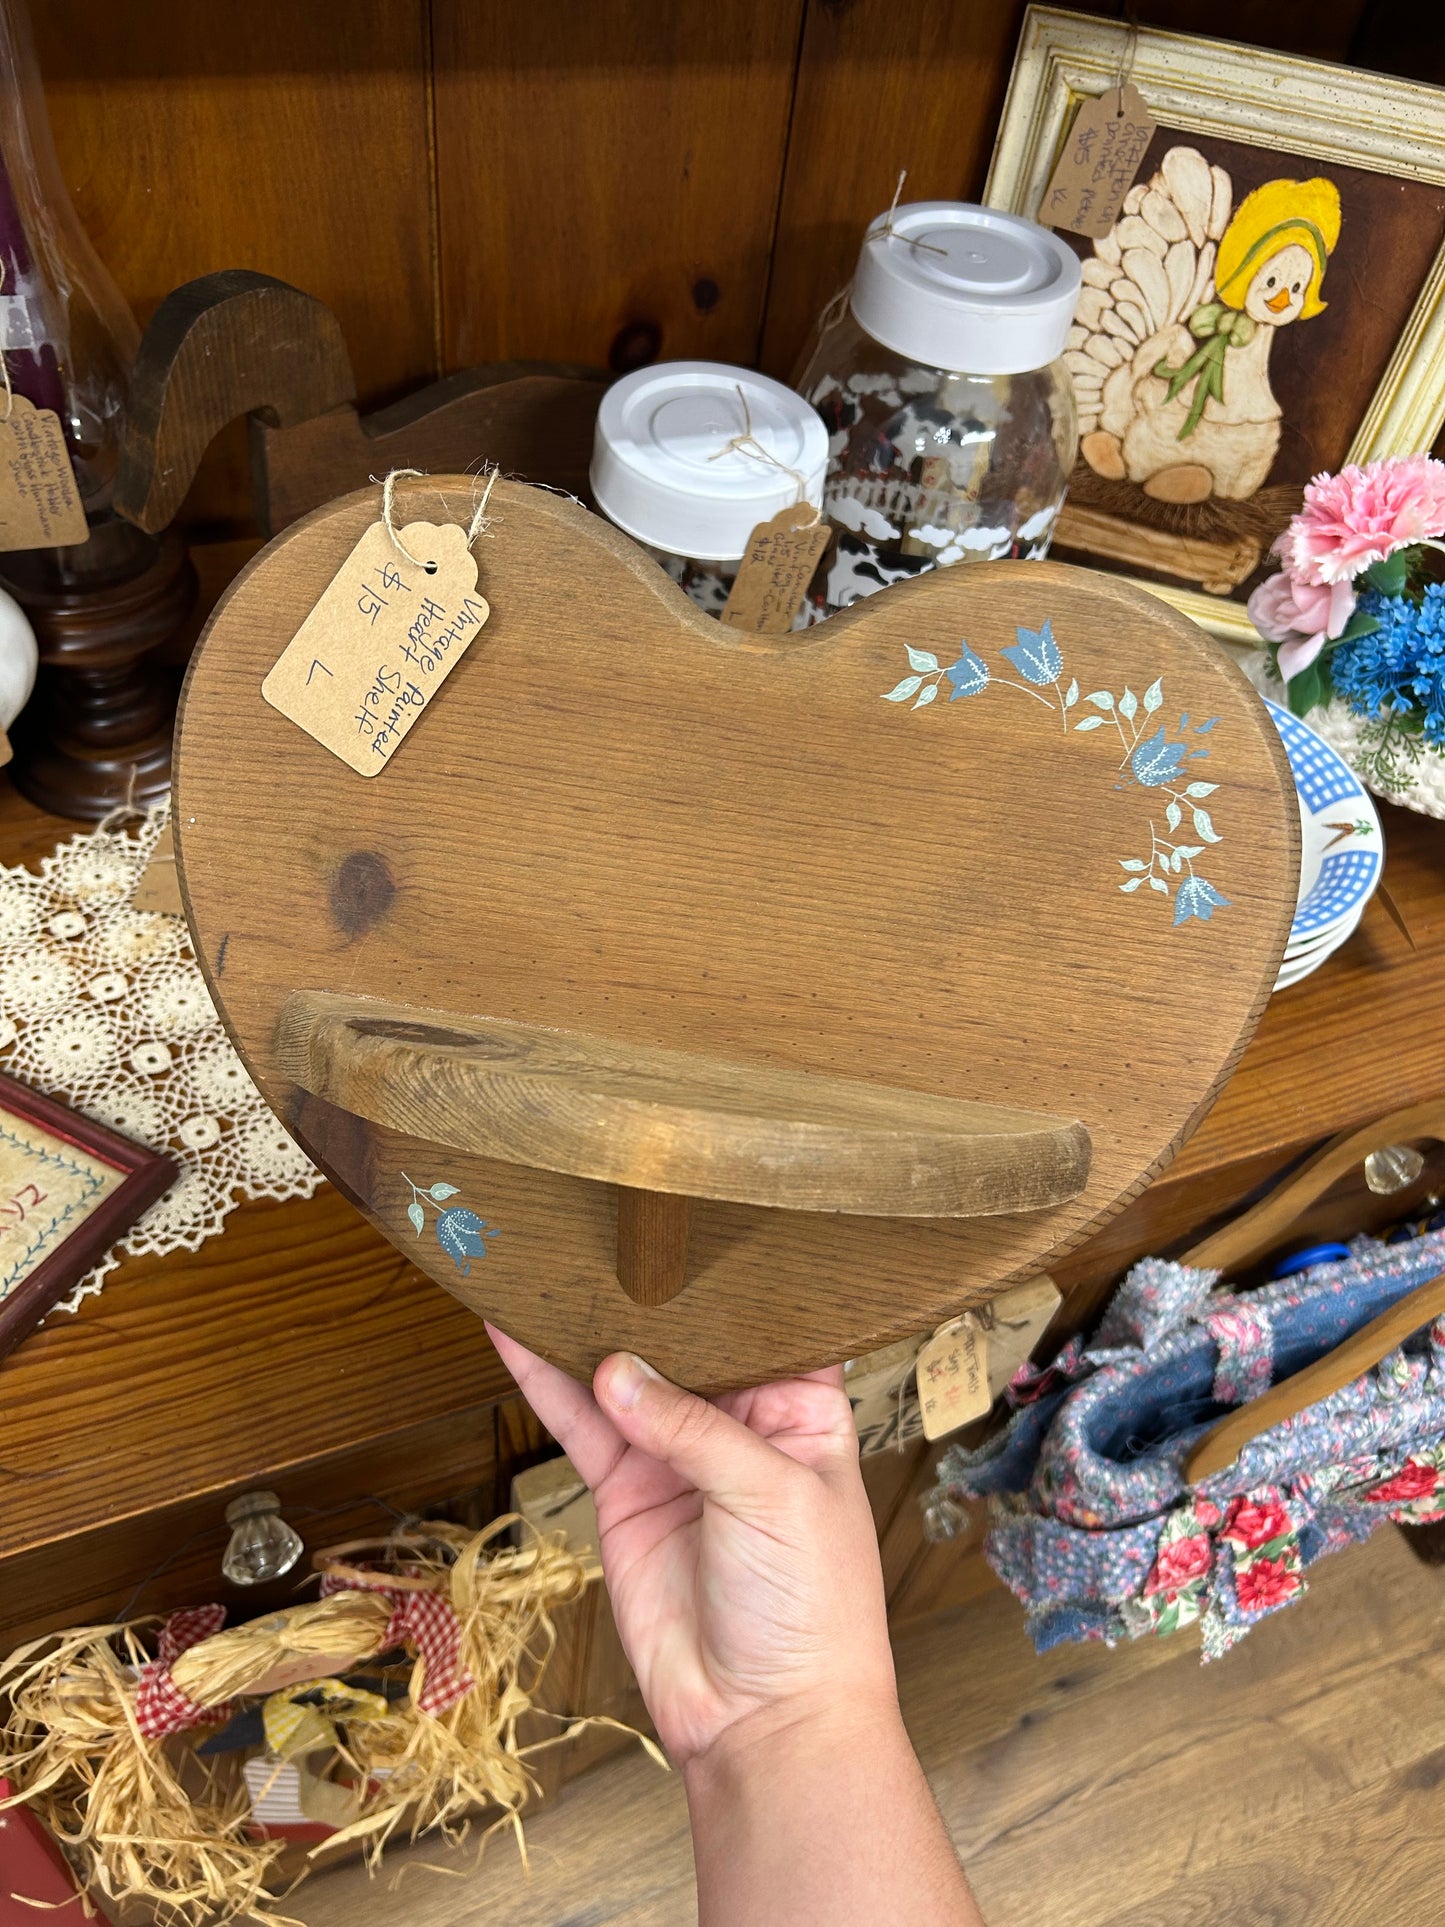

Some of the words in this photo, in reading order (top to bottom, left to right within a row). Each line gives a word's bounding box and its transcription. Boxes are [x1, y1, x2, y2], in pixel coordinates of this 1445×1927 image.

[41, 414, 62, 467] Vintage
[750, 537, 772, 565] $12
[780, 541, 808, 593] Vintage
[399, 597, 447, 663] Heart
[418, 598, 482, 674] Vintage
[306, 660, 334, 685] L
[355, 664, 401, 734] Shelf
[372, 682, 425, 757] Painted
